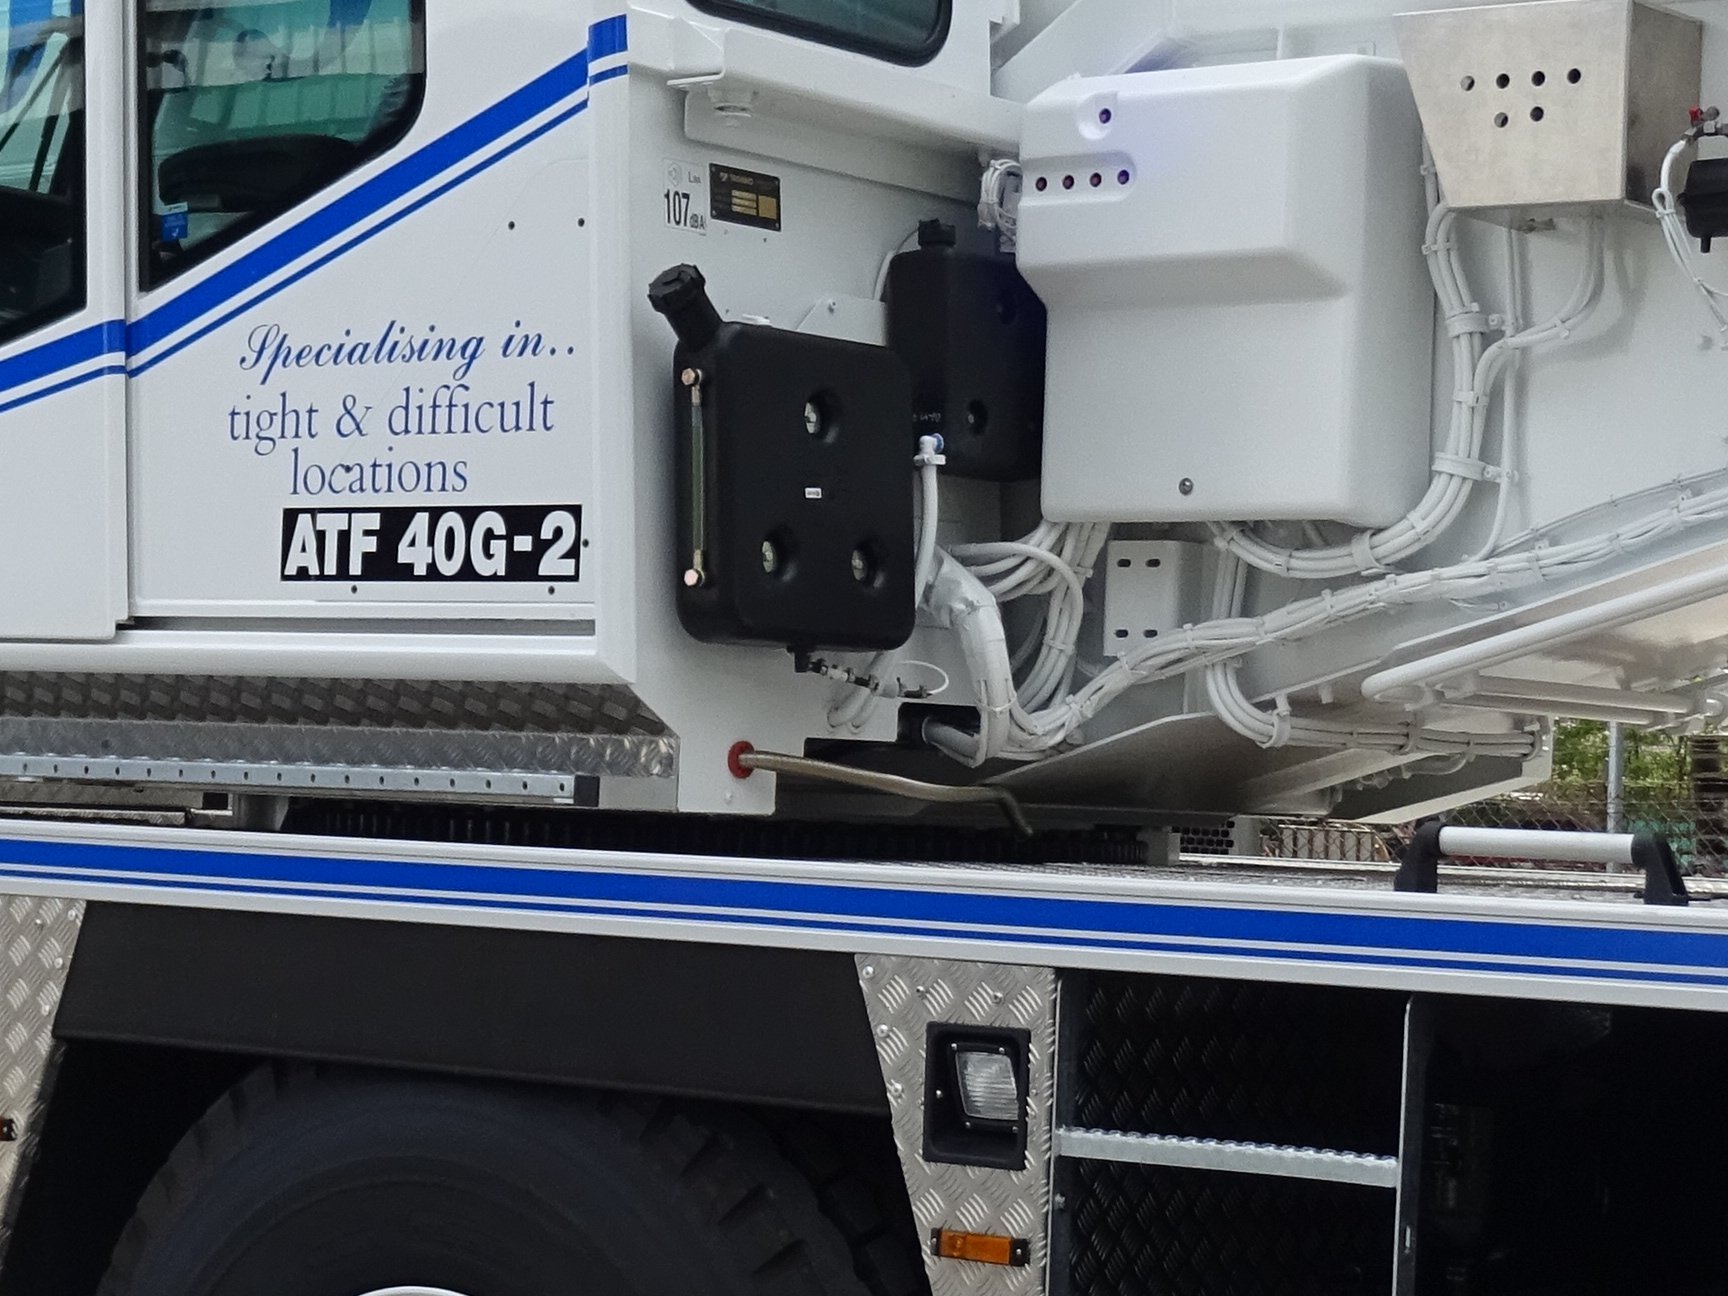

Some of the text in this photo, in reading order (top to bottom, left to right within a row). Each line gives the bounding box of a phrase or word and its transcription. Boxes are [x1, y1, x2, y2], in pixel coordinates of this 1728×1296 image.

[664, 188, 690, 226] 107
[238, 319, 486, 386] Specialising
[227, 380, 555, 456] tight & difficult
[288, 446, 469, 496] locations
[283, 509, 576, 577] ATF 40G-2
